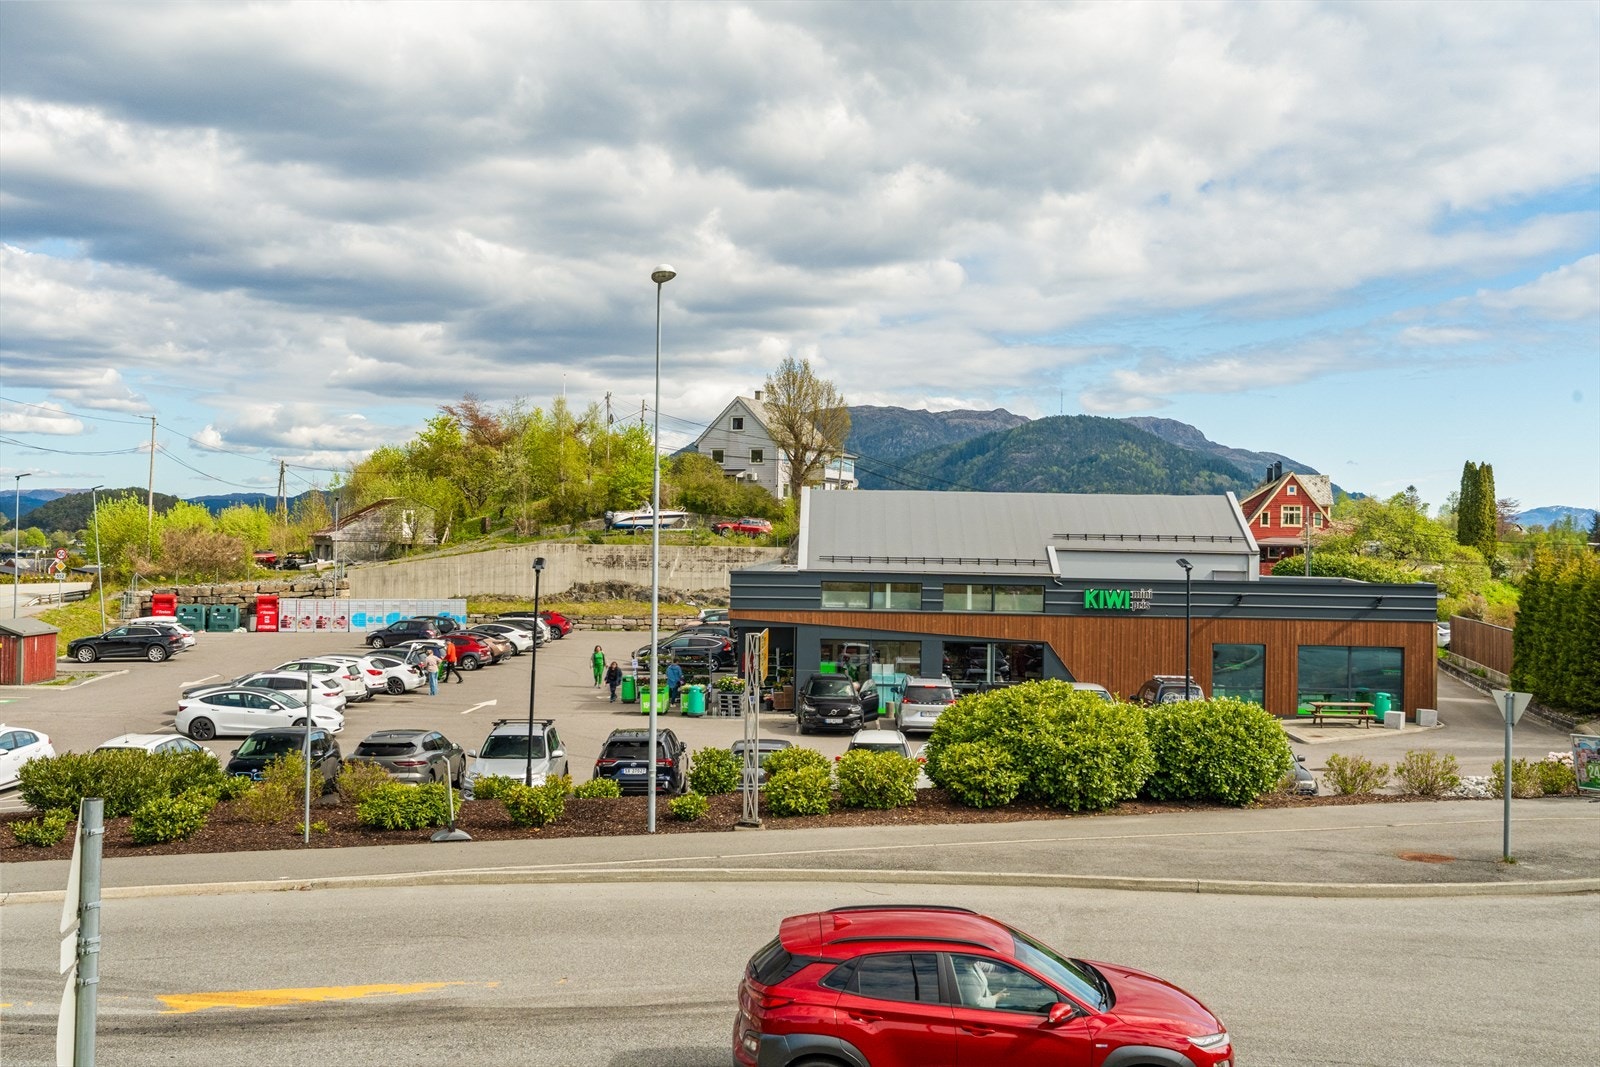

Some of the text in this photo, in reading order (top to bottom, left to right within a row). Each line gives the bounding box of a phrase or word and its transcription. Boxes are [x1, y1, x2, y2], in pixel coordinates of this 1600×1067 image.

[1084, 589, 1130, 609] KIWI
[1132, 588, 1152, 599] mini
[1132, 599, 1151, 611] pris
